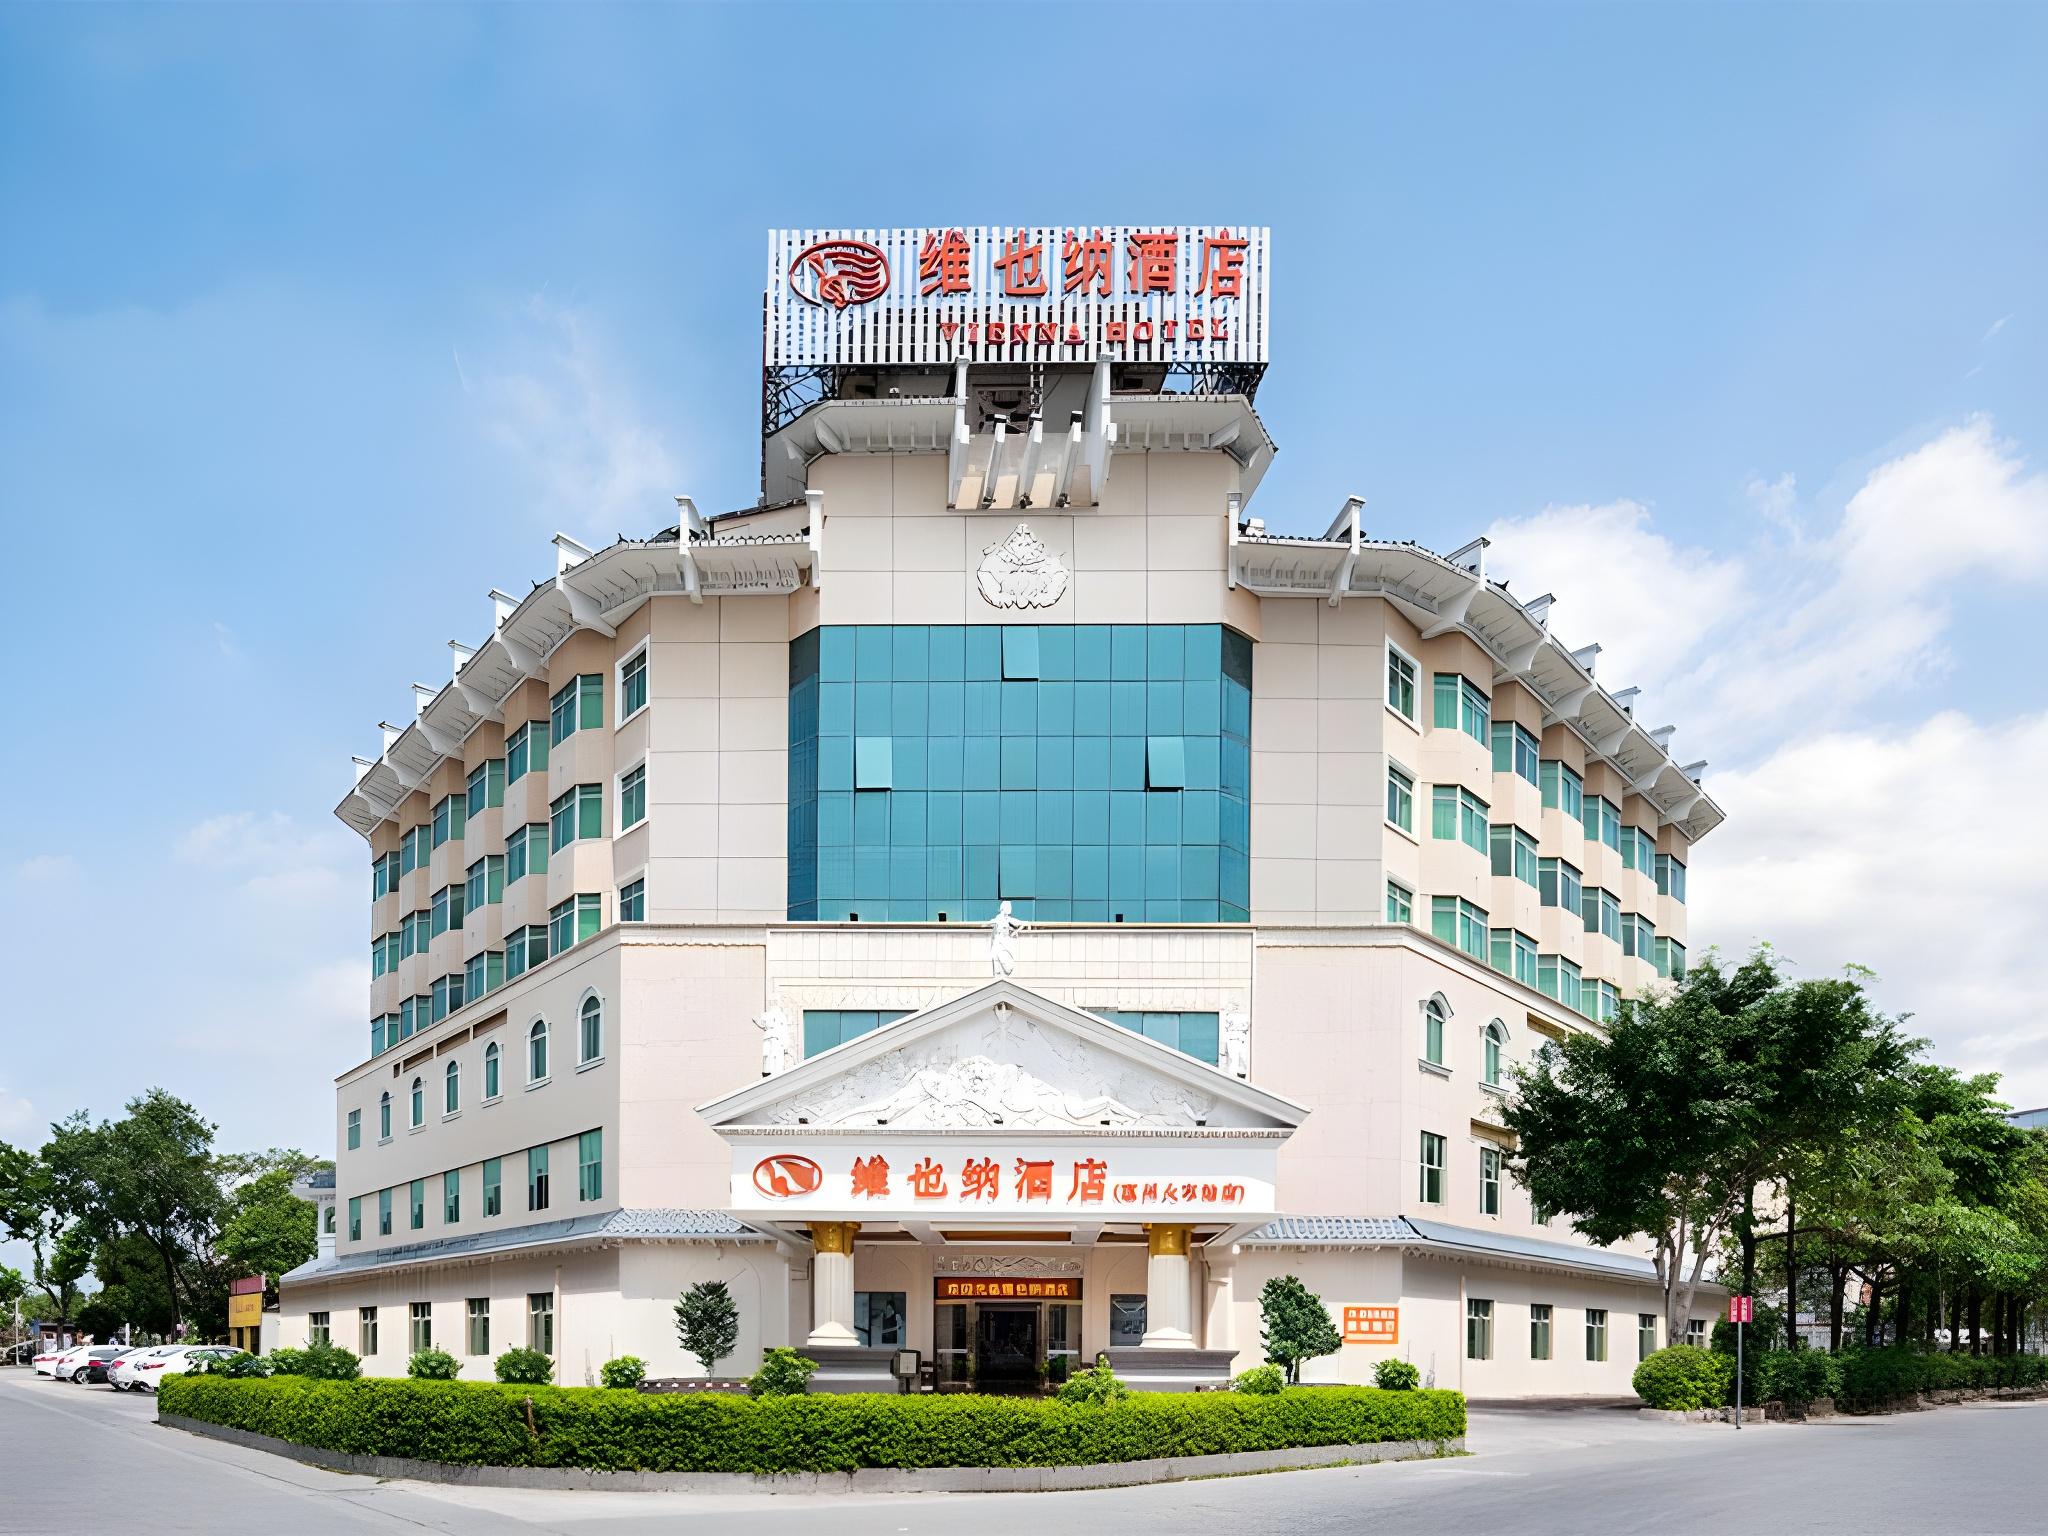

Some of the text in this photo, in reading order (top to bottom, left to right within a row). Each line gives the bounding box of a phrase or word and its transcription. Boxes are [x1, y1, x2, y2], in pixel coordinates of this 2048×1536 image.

[920, 228, 1249, 298] 维也纳酒店
[850, 1154, 1108, 1202] 维也纳酒店
